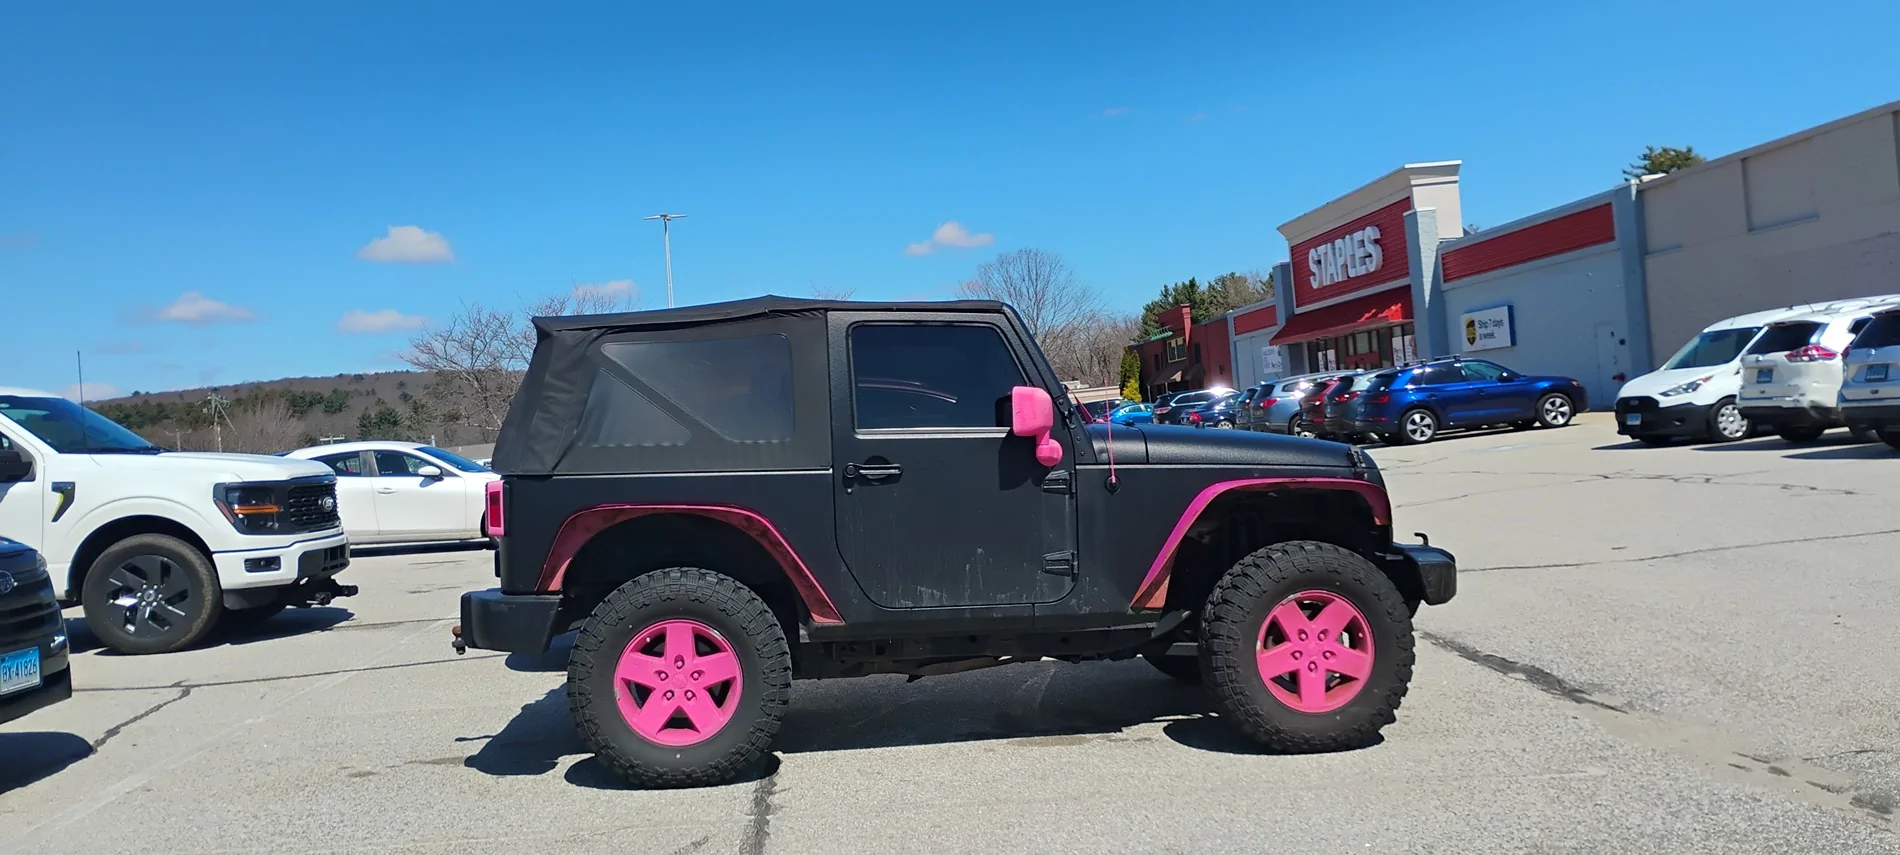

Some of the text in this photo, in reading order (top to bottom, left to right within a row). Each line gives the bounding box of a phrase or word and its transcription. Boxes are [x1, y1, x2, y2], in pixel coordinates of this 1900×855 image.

[1308, 225, 1383, 289] STAPLES
[1477, 319, 1489, 330] Ship
[1492, 319, 1504, 329] days
